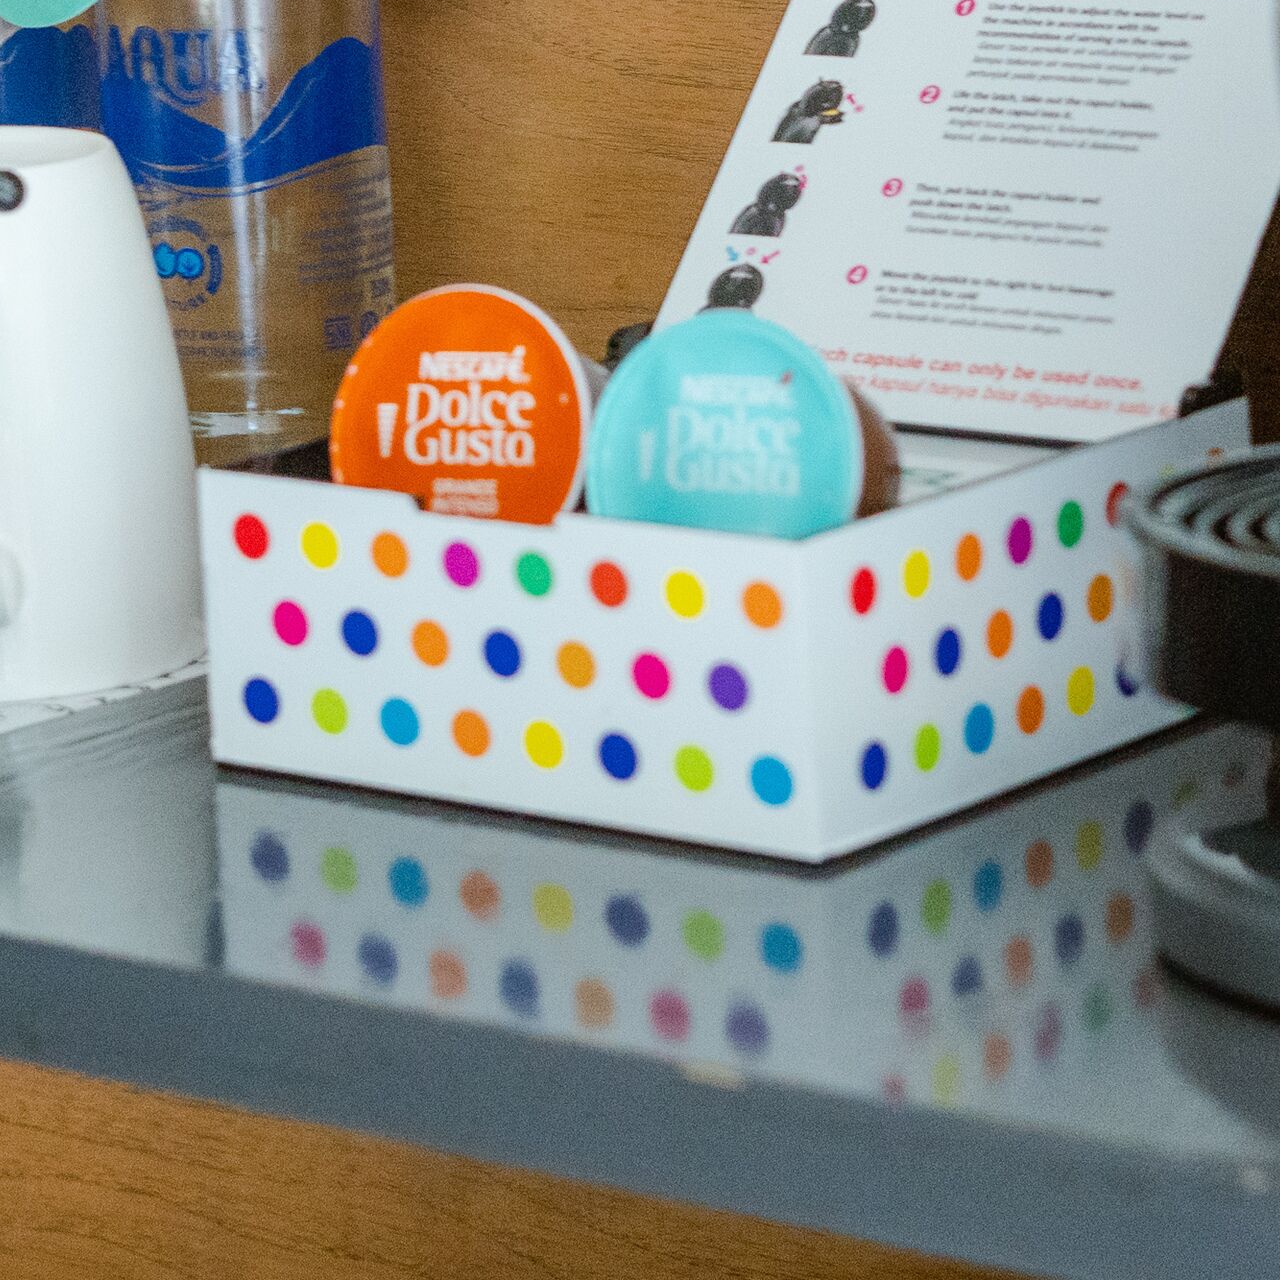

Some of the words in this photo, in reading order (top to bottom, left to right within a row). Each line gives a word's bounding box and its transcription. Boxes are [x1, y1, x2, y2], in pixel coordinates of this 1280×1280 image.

[851, 352, 924, 371] capsule
[927, 359, 963, 373] can
[967, 361, 1008, 381] only
[1012, 363, 1036, 381] be
[1040, 369, 1090, 386] used
[407, 381, 537, 429] Dolce
[404, 421, 536, 466] Gusto
[667, 405, 801, 453] Dolce
[665, 449, 801, 496] Gusto
